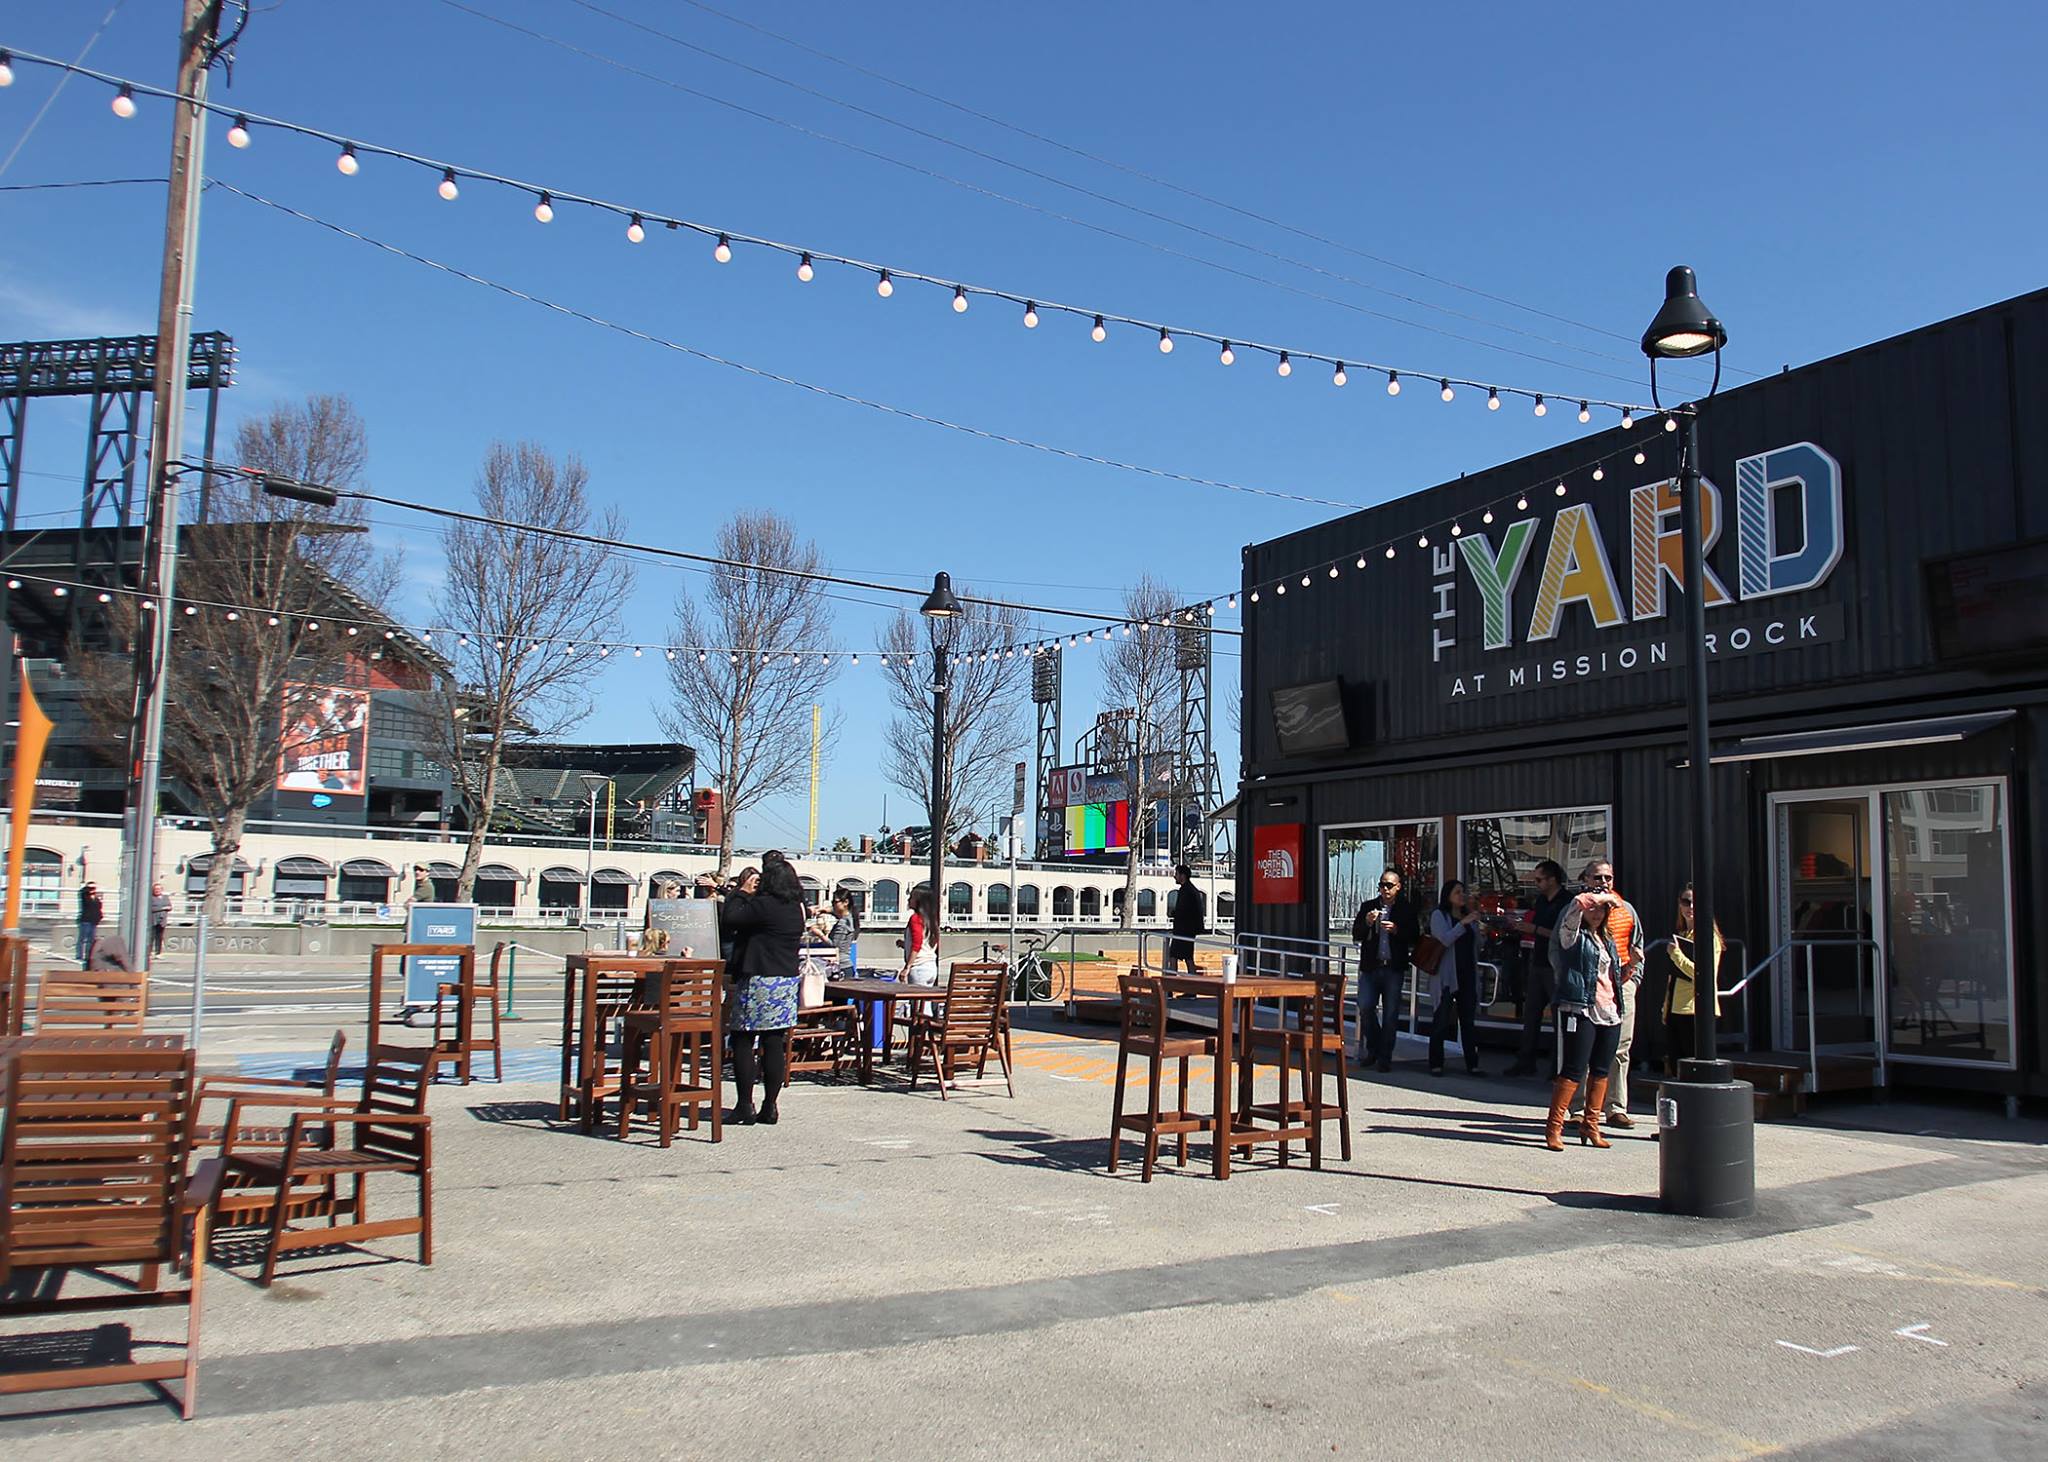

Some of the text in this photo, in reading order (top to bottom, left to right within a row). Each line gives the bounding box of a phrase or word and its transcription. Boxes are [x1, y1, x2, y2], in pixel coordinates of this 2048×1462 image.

[1457, 441, 1843, 651] YARD
[1433, 541, 1456, 663] THE
[1451, 615, 1818, 697] AT MISSION ROCK
[297, 751, 350, 770] TOGETHER
[1267, 850, 1281, 859] THE
[1258, 859, 1281, 870] NORTH
[1263, 869, 1281, 878] FACE
[215, 935, 270, 951] PARK
